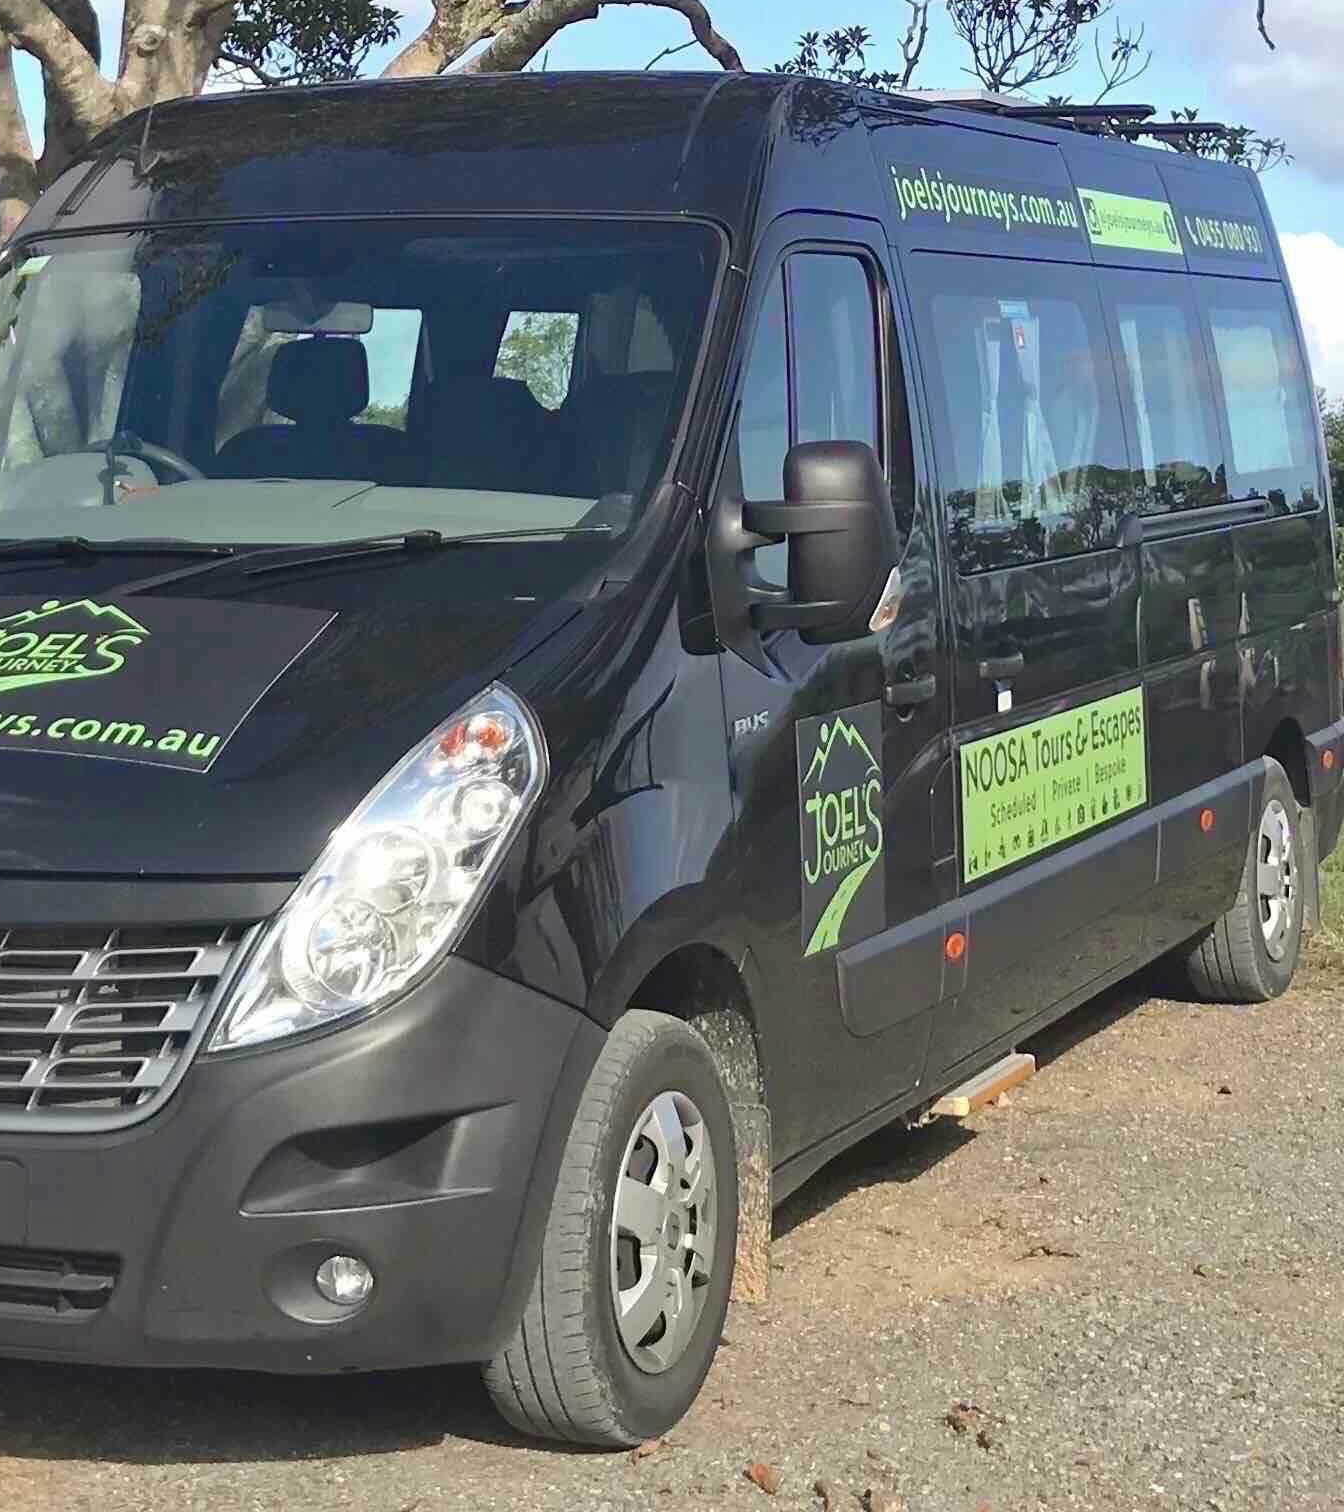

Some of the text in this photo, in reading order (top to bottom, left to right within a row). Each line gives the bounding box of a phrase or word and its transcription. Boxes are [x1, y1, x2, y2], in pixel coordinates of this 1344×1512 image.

[890, 165, 1079, 232] joelsjourneys.com.au
[964, 704, 1142, 798] NOOSA Tours & Escapes
[805, 778, 884, 885] JOEL'S
[990, 757, 1127, 828] Scheduled Private Bespoke
